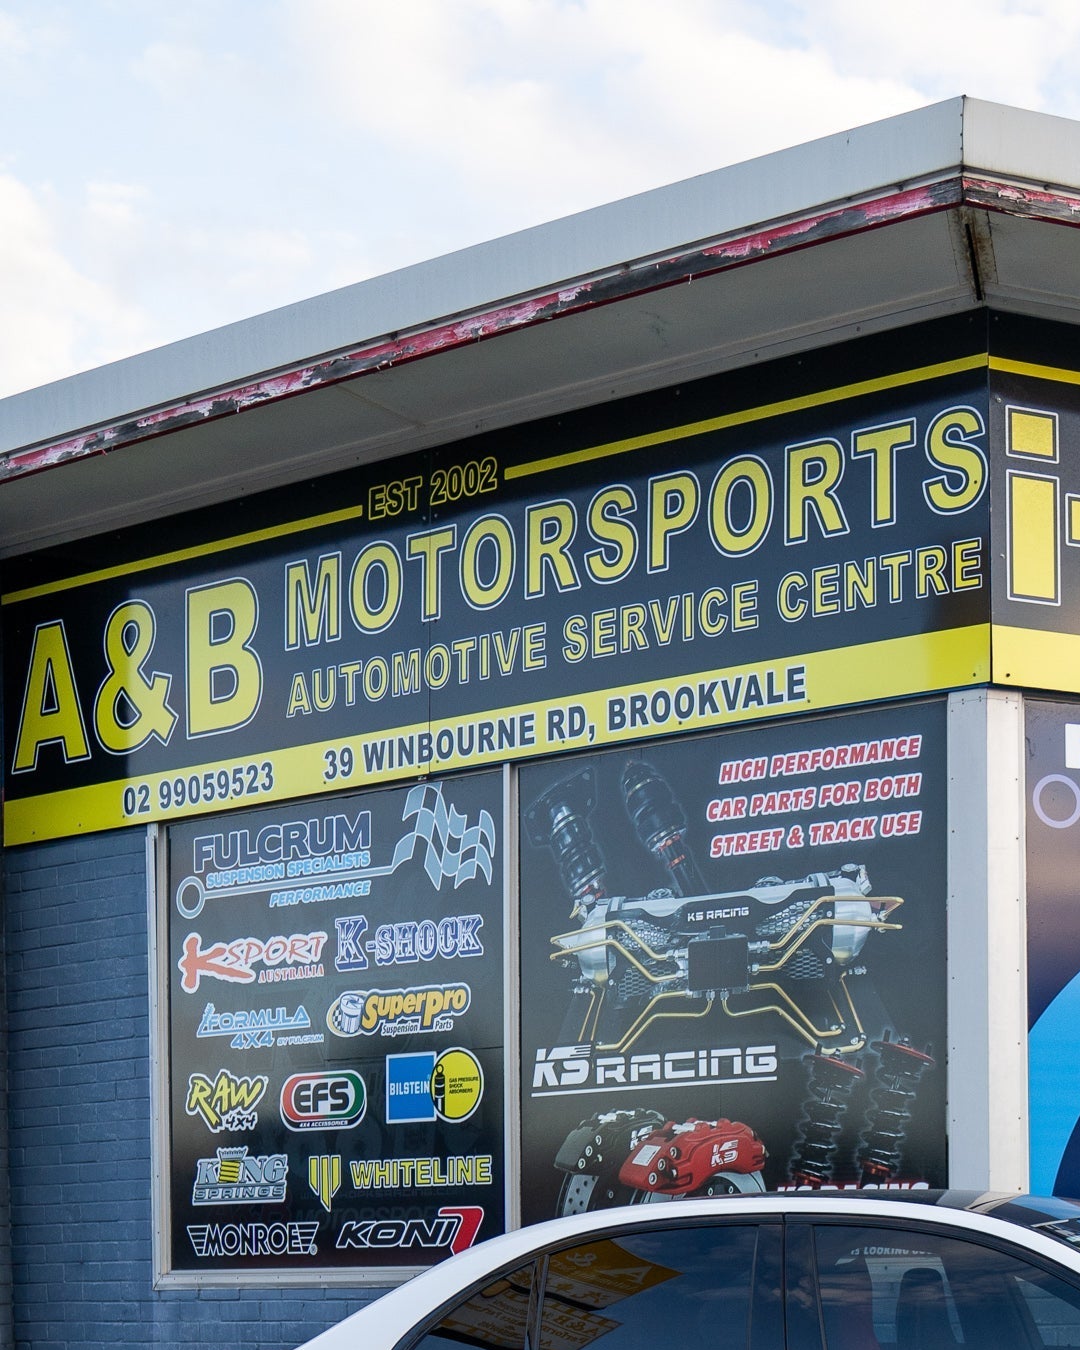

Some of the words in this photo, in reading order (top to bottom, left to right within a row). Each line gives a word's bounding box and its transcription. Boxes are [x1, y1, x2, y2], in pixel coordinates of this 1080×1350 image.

[368, 477, 422, 520] EST
[430, 457, 498, 505] 2002
[285, 405, 988, 651] MOTORSPORTS
[286, 624, 547, 718] AUTOMOTIVE
[562, 580, 759, 664] SERVICE
[778, 537, 982, 622] CENTRE
[11, 577, 264, 775] A&B
[324, 749, 353, 781] 39
[363, 712, 535, 773] WINBOURNE
[547, 704, 595, 742] RD,
[608, 666, 806, 732] BROOKVALE
[719, 758, 768, 786] HIGH
[770, 735, 922, 777] PERFORMANCE
[123, 785, 150, 817] 02
[158, 762, 274, 811] 99059523
[706, 796, 747, 823] CAR
[748, 787, 814, 819] PARTS
[818, 780, 860, 809] FOR
[864, 772, 922, 800] BOTH
[194, 810, 371, 873] FULCRUM
[709, 827, 782, 858] STREET
[786, 825, 804, 848] &
[809, 815, 878, 845] TRACK
[880, 810, 922, 839] USE
[206, 863, 285, 889] SUSPENSION
[287, 851, 371, 879] SPECIALISTS
[269, 880, 372, 908] PERFORMANCE
[335, 915, 484, 972] K-SHOCK
[258, 966, 325, 984] AUSTRALIA
[288, 1034, 324, 1046] FULCRUM
[382, 1022, 418, 1035] Suspension
[435, 1020, 453, 1031] Parts
[532, 1044, 592, 1088] KS
[295, 1081, 350, 1113] EFS
[195, 1187, 284, 1200] SPRINGS
[350, 1155, 492, 1189] WHITELINE
[203, 1222, 304, 1255] MONROE
[336, 1219, 460, 1249] KONI
